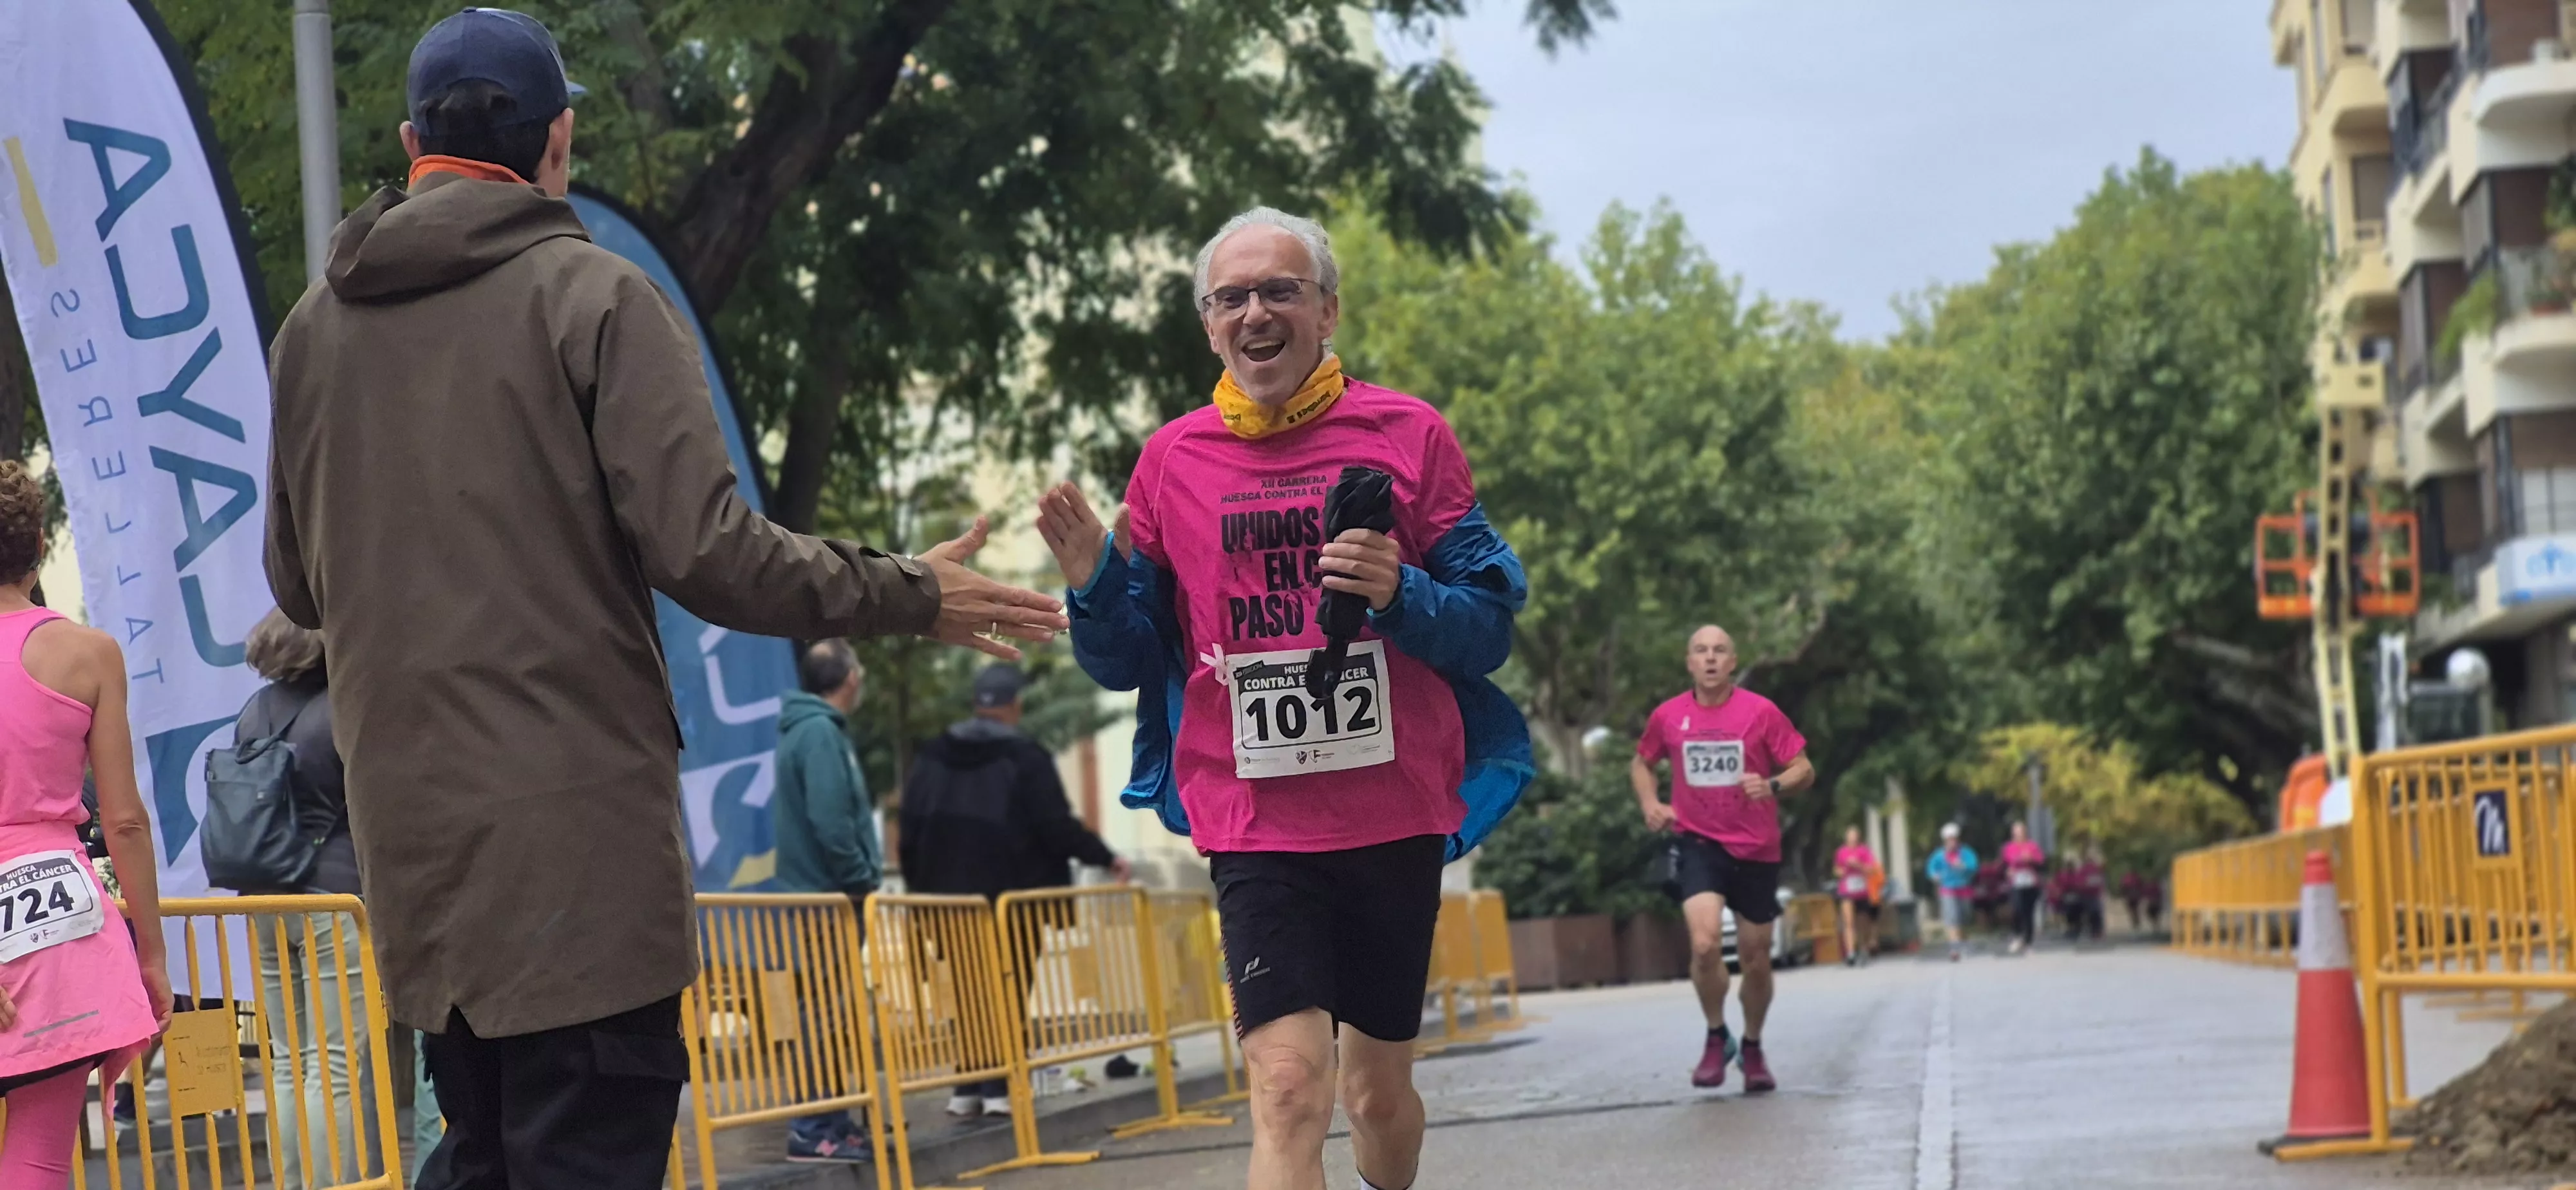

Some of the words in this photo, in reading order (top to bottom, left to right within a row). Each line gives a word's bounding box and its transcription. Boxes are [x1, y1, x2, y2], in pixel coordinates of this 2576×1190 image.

[1278, 475, 1327, 487] CARRERA
[1220, 491, 1261, 504] HUESCA
[1264, 487, 1307, 500] CONTRA
[1311, 486, 1324, 495] EL
[1222, 506, 1320, 554] UNIDOS
[1264, 551, 1300, 592] EN
[1229, 594, 1305, 641] PASO
[1244, 675, 1296, 690] CONTRA
[1298, 674, 1306, 686] E
[1245, 686, 1376, 741] 1012
[1690, 756, 1738, 773] 3240
[6, 865, 37, 880] HUESCA
[18, 874, 32, 885] EL
[32, 864, 73, 880] CÁNCER
